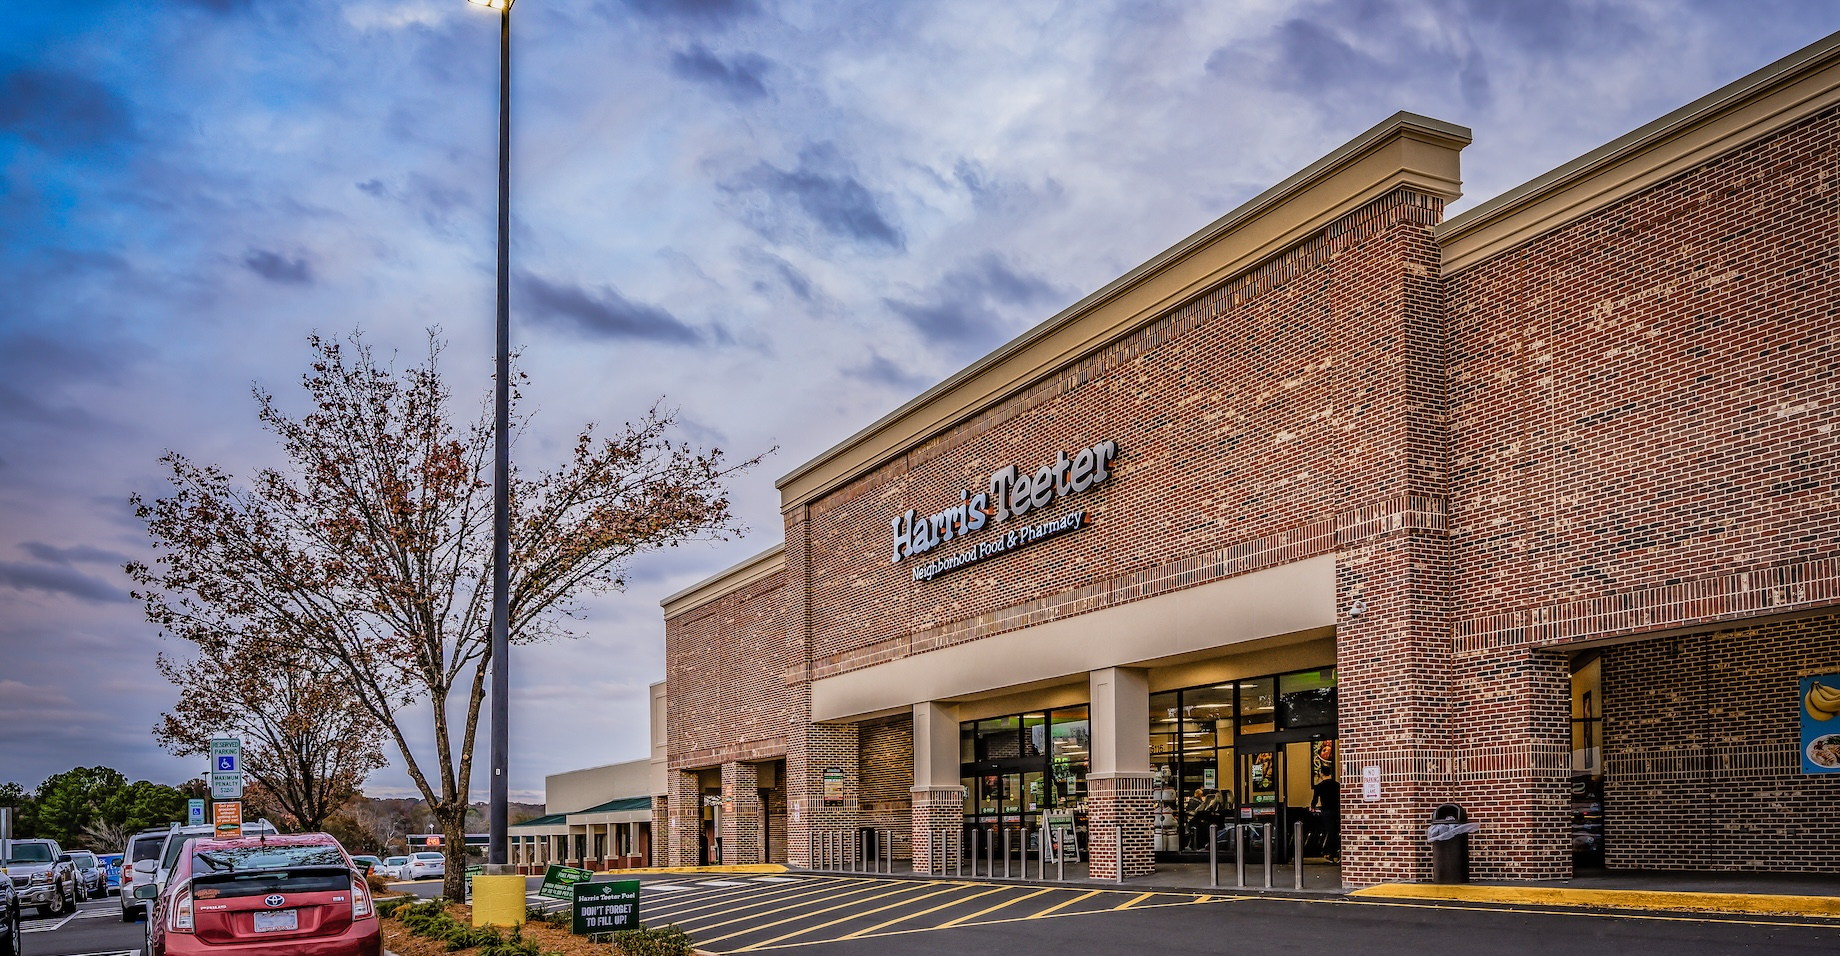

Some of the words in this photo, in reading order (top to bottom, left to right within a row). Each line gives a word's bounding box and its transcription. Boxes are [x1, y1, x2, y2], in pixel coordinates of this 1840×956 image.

[891, 488, 989, 563] Harris
[990, 440, 1117, 522] Teeter
[912, 545, 978, 582] Neighborhood
[979, 537, 1005, 558] Food
[1006, 530, 1019, 549] &
[1020, 511, 1084, 543] Pharmacy
[581, 906, 604, 916] DON'T
[605, 904, 632, 914] FORGET
[586, 917, 596, 927] TO
[597, 916, 613, 926] FILL
[615, 915, 627, 924] UP!
